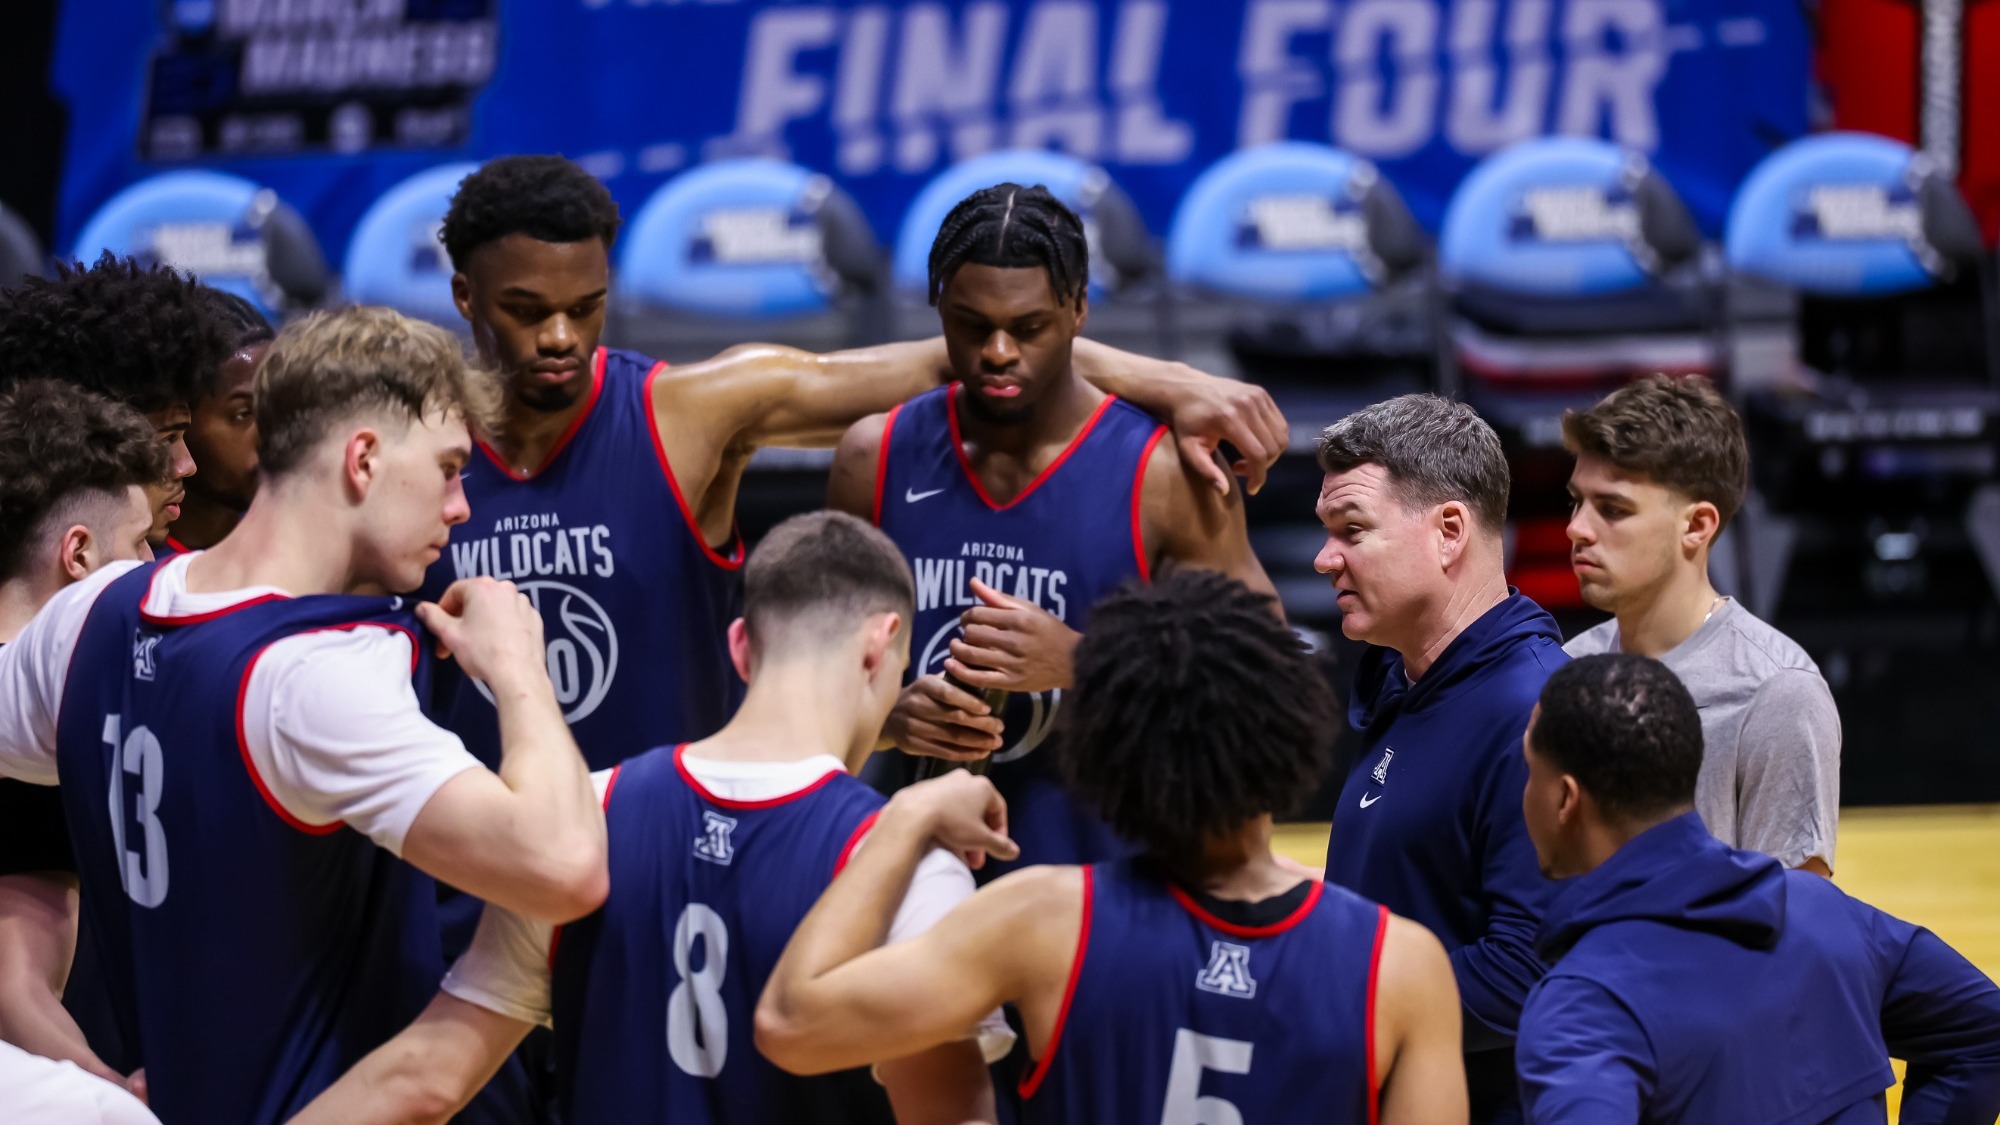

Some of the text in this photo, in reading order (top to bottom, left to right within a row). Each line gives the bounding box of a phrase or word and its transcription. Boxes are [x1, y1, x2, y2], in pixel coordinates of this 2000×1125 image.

[241, 20, 497, 93] MADNESS
[733, 0, 1672, 172] FINAL FOUR
[451, 524, 614, 580] WILDCATS
[494, 512, 560, 533] ARIZONA
[961, 542, 1024, 562] ARIZONA
[914, 557, 1067, 622] WILDCATS
[1371, 747, 1395, 786] A
[102, 713, 170, 909] 13
[693, 810, 738, 866] A
[667, 903, 728, 1079] 8
[1195, 940, 1257, 1000] A
[1160, 1027, 1254, 1125] 5
